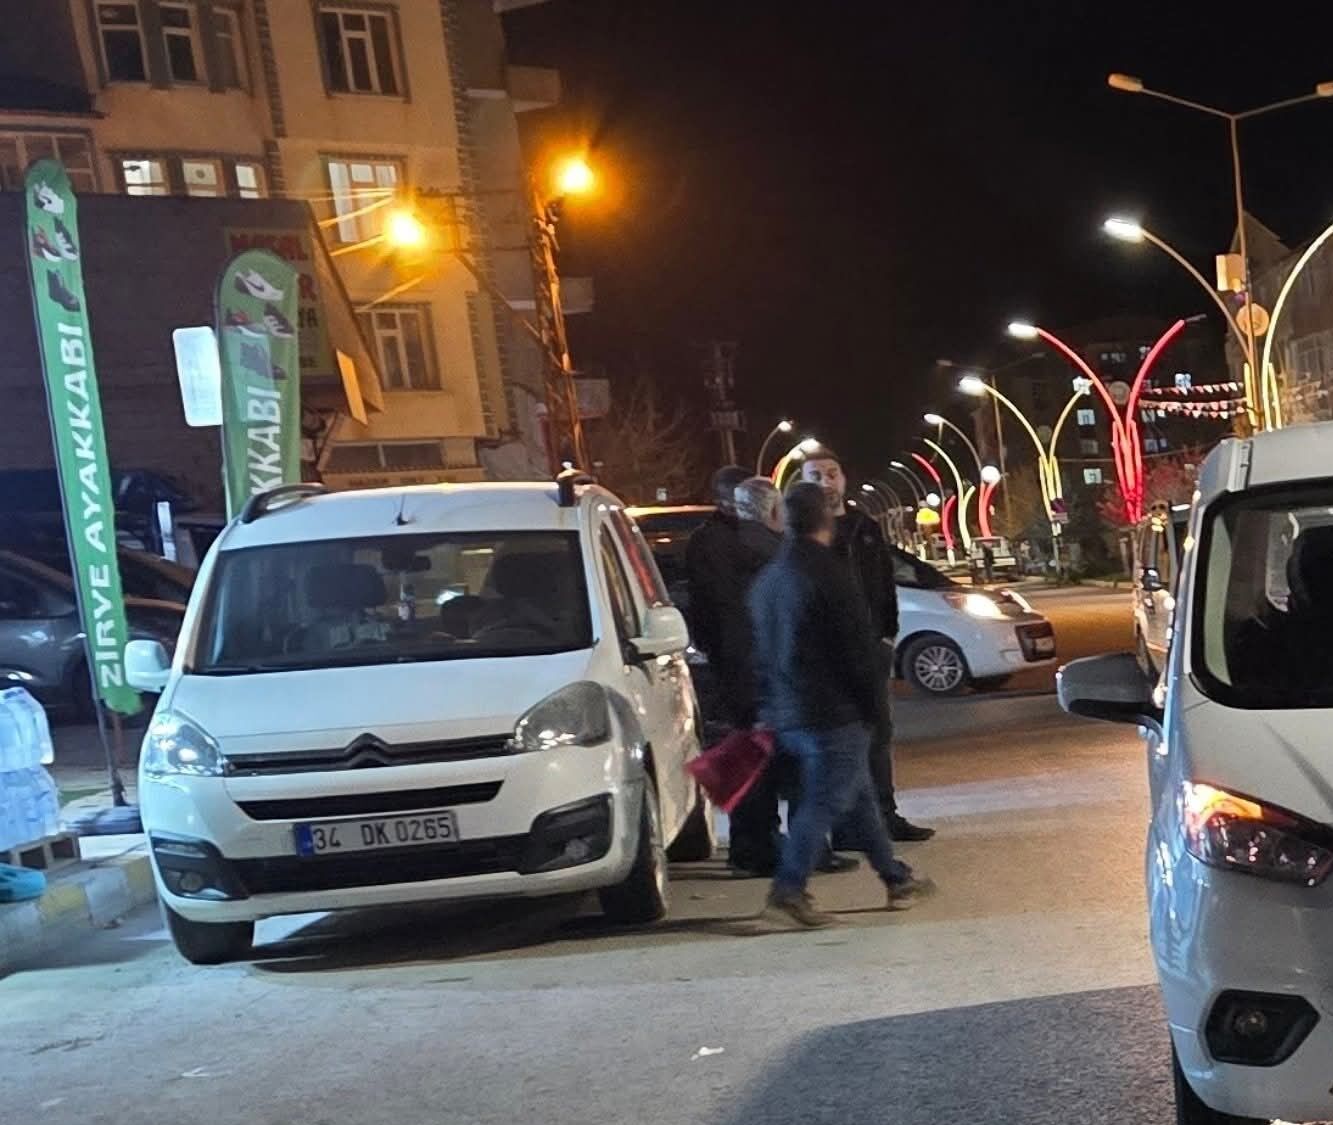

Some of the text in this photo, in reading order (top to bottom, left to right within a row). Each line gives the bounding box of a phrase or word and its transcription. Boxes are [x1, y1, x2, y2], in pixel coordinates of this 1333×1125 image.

[57, 322, 108, 554] AYAKKABI
[246, 385, 284, 496] KKABI
[313, 816, 451, 850] 34 DK 0265
